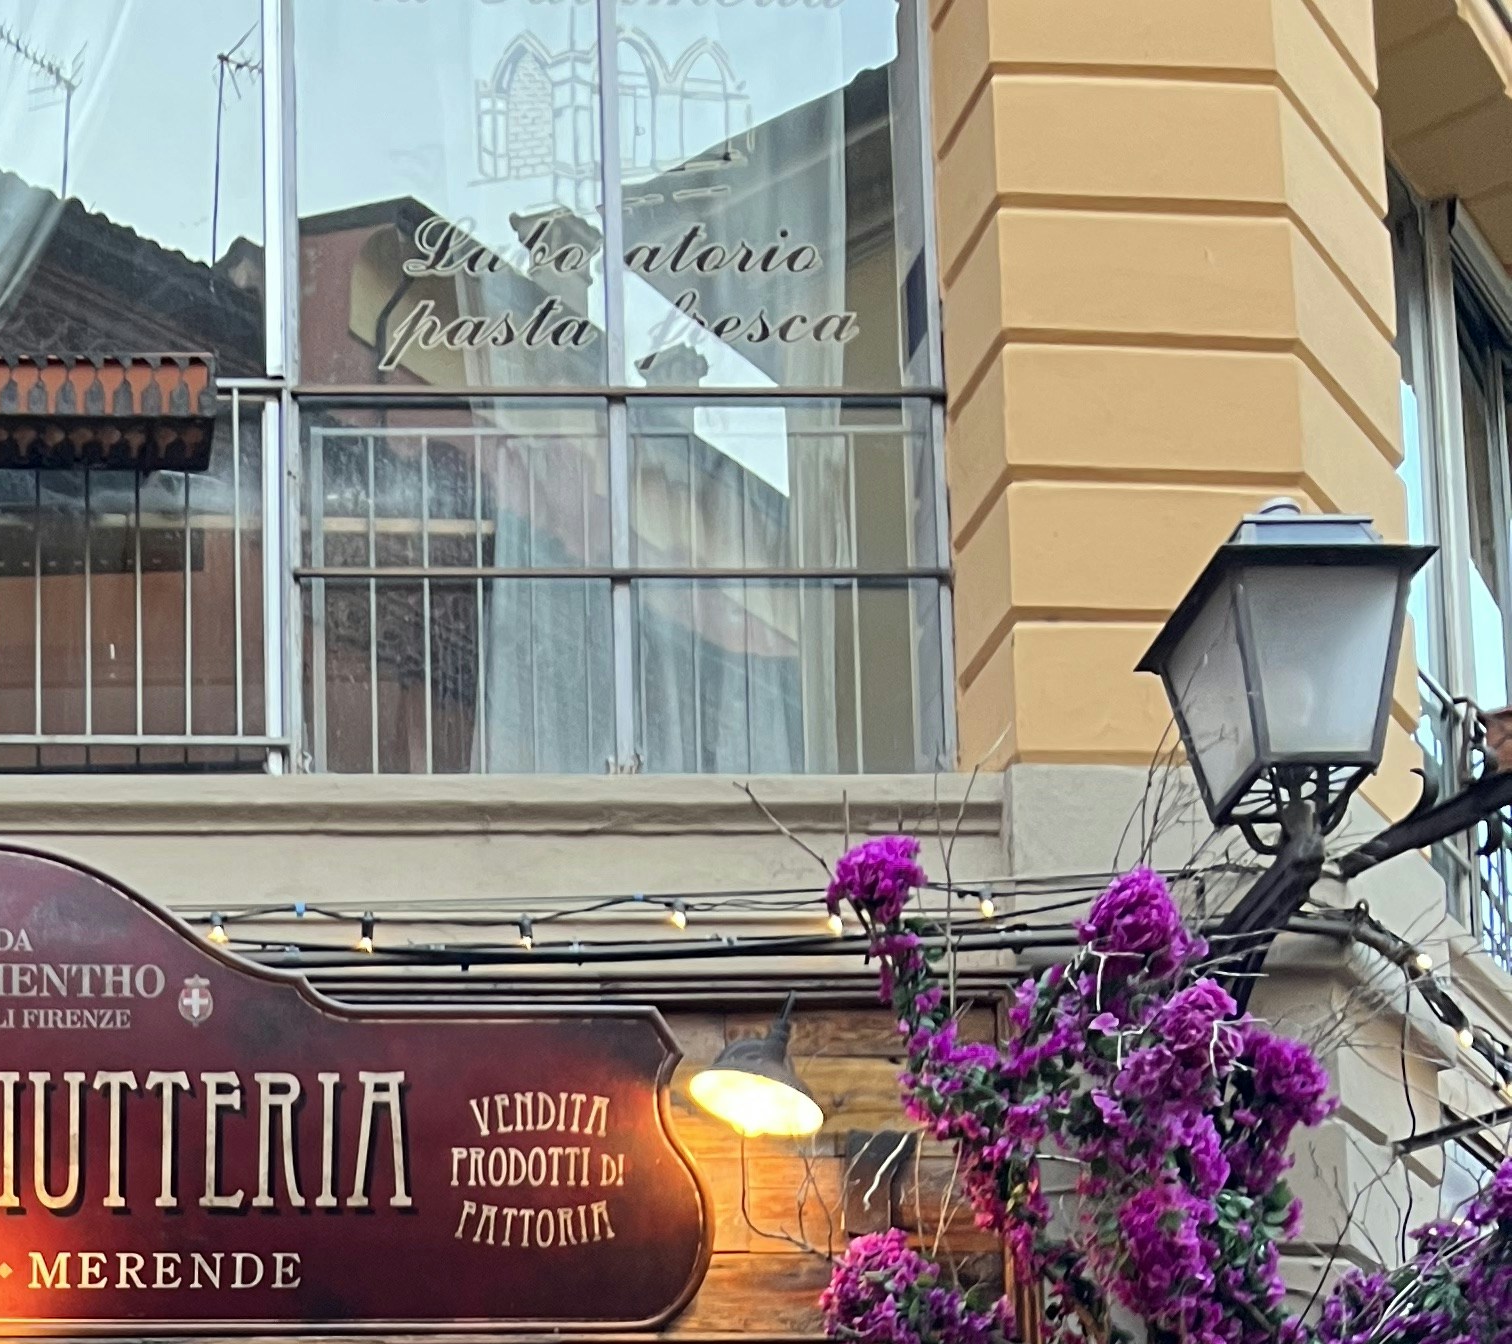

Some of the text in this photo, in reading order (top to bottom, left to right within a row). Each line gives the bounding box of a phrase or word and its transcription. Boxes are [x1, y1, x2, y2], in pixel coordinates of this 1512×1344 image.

[401, 215, 822, 279] Laboatorio
[378, 295, 599, 372] pasta
[22, 1008, 132, 1029] FIRENZE
[469, 1091, 611, 1138] VENDITA
[450, 1147, 591, 1187] PRODOTTI
[454, 1200, 617, 1248] FATTORIA
[28, 1251, 302, 1289] MERENDE
